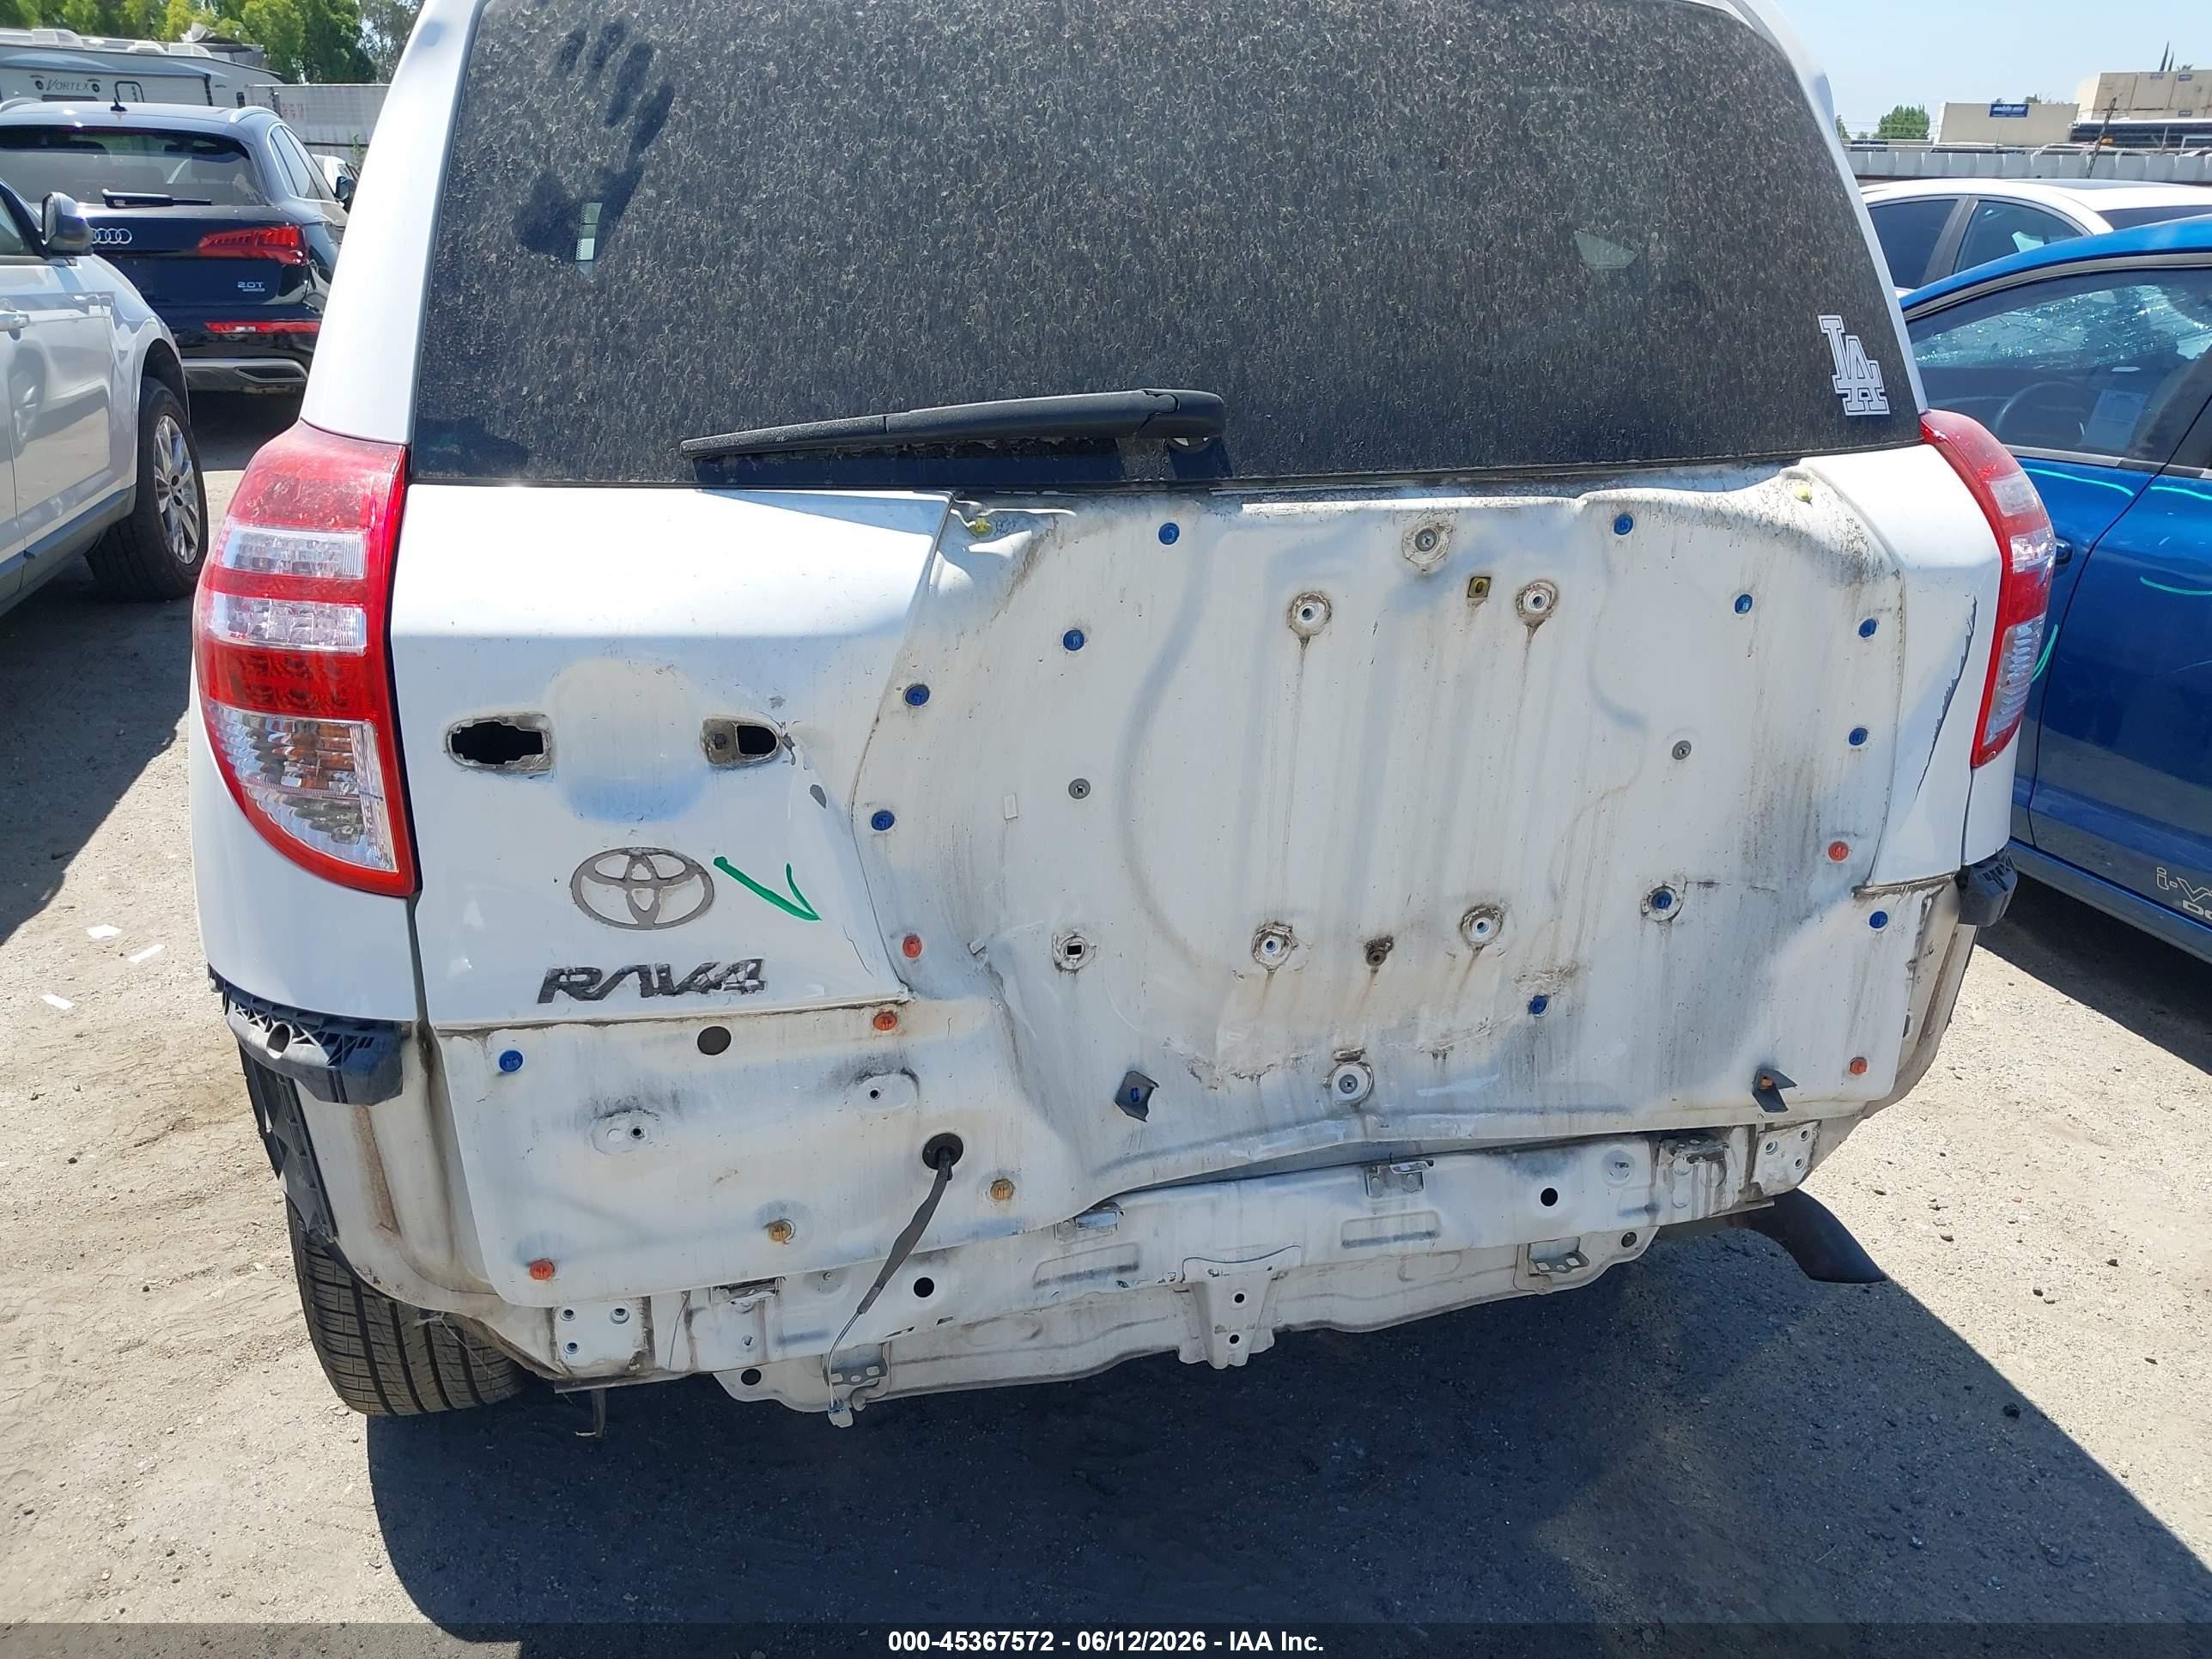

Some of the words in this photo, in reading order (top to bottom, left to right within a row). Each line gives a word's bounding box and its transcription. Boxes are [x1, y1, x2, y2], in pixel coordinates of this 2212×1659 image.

[46, 78, 89, 91] VORTEX
[1817, 314, 1890, 416] LA
[2156, 866, 2212, 902] i-V
[538, 958, 767, 1004] RAV4
